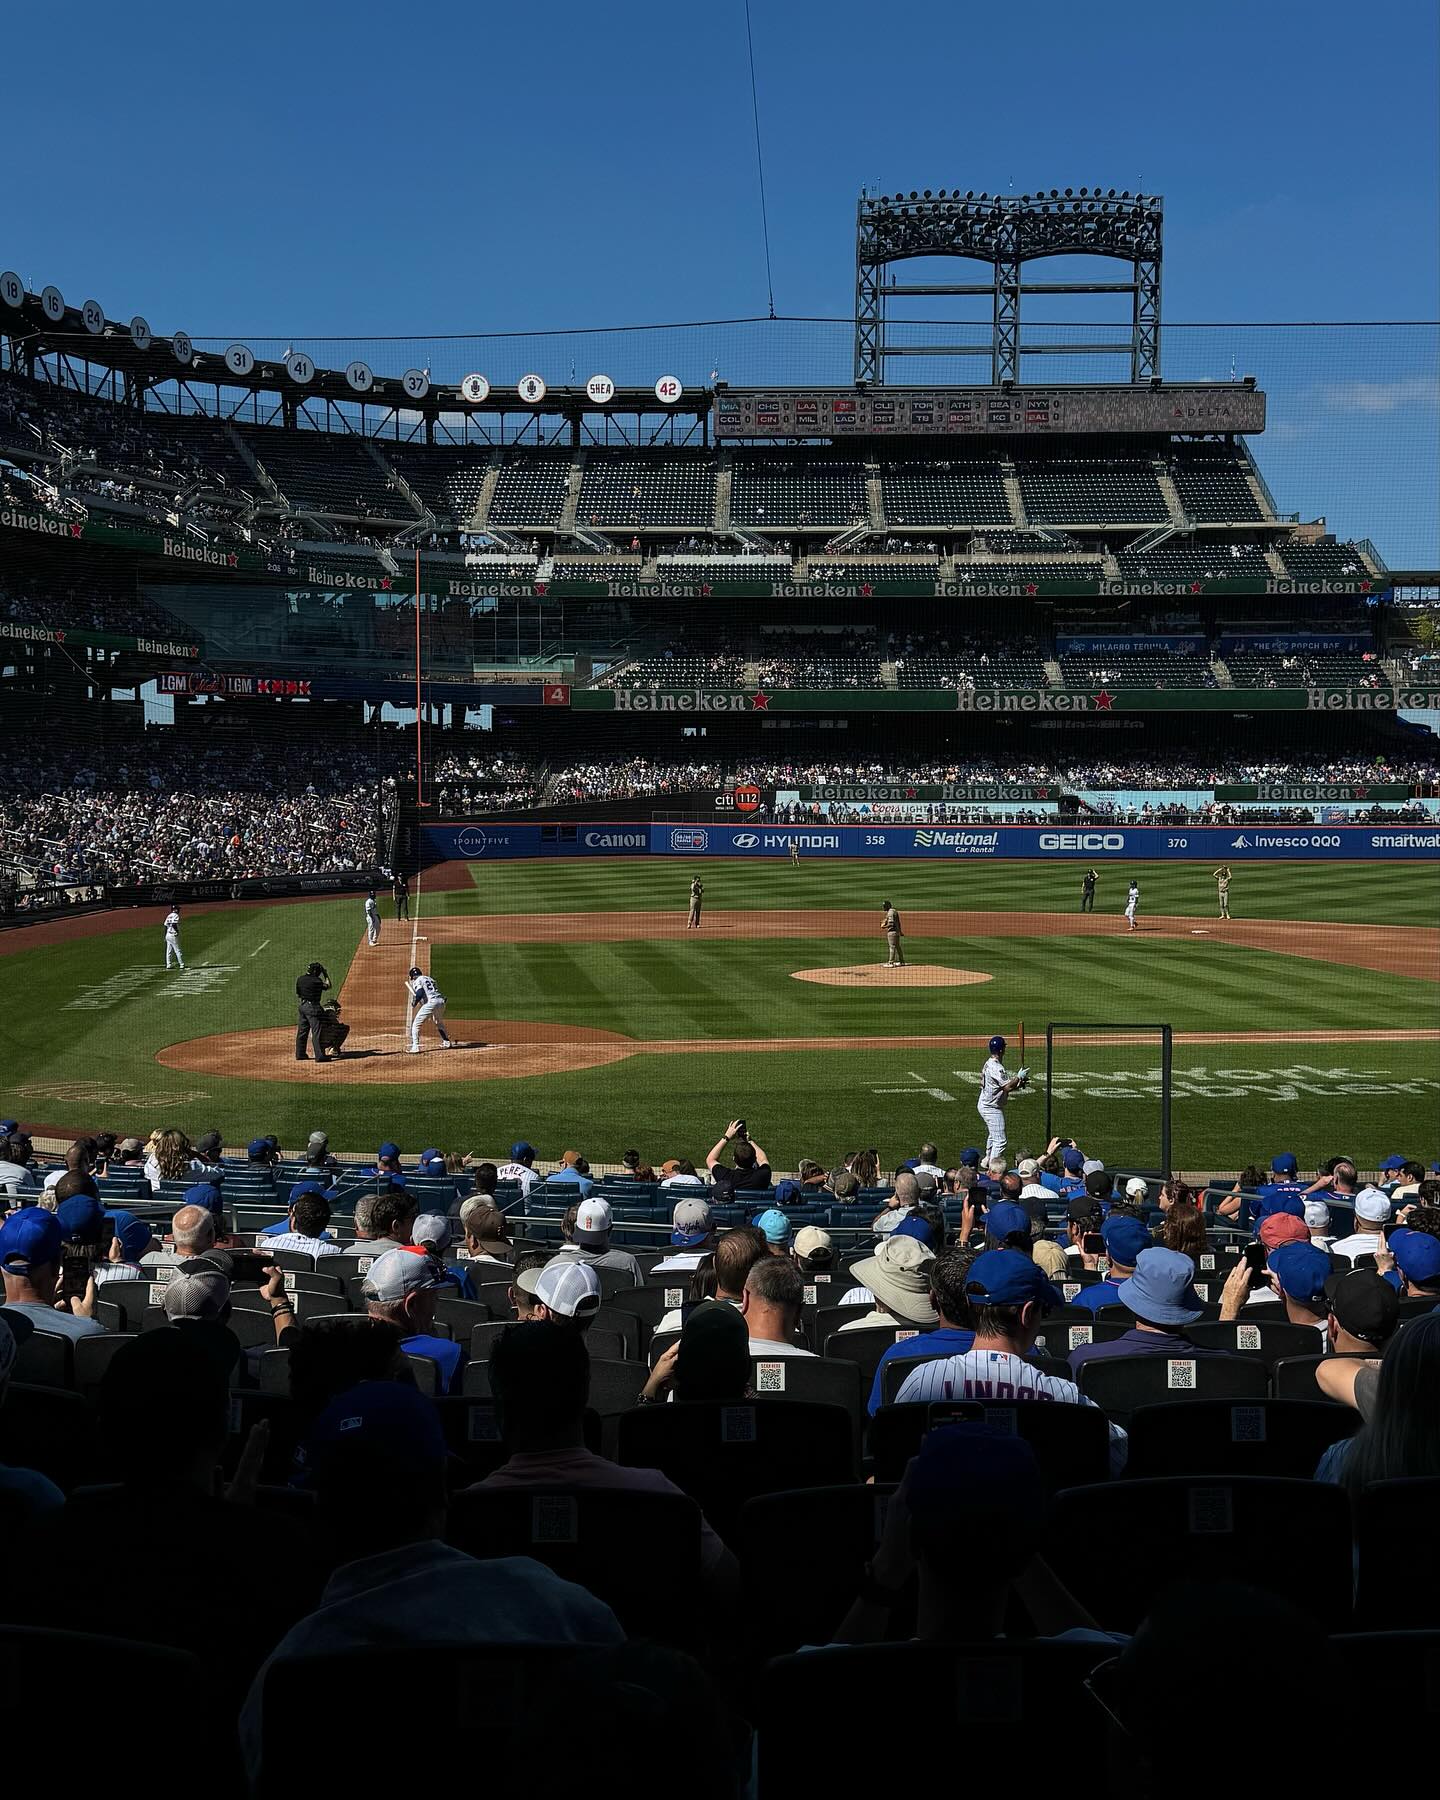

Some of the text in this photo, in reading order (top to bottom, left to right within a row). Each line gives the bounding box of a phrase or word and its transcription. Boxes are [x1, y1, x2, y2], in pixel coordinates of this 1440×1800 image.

[6, 282, 18, 298] 18
[46, 296, 59, 312] 16
[87, 309, 100, 325] 24
[135, 324, 146, 341] 17
[177, 340, 189, 356] 36
[233, 352, 247, 367] 31
[294, 361, 308, 376] 41
[353, 369, 366, 384] 14
[408, 376, 423, 391] 37
[590, 384, 611, 394] SHEA
[660, 382, 677, 396] 42
[1187, 408, 1231, 417] DELTA
[0, 507, 69, 537] eineken
[163, 537, 228, 567] Heineken
[308, 566, 378, 590] Heineken
[449, 580, 533, 597] Heineken
[608, 582, 695, 598] Heineken
[772, 582, 858, 598] Heineken
[934, 581, 1022, 596] Heineken
[1098, 580, 1187, 596] Heineken
[1266, 579, 1356, 595] Heineken
[137, 637, 190, 658] Heineken
[161, 674, 187, 691] LGM
[228, 677, 252, 693] LGM
[551, 688, 564, 703] 4
[613, 689, 747, 711] Heineken
[957, 689, 1089, 711] Heineken
[1306, 688, 1440, 710] Heineken
[740, 793, 757, 803] 112
[812, 785, 902, 800] Heineken
[942, 785, 1034, 800] Heineken
[1256, 784, 1351, 800] Heineken
[715, 794, 734, 806] citi
[872, 801, 901, 814] Coors
[901, 805, 928, 814] LIGHT
[453, 836, 510, 846] 1POINTFIVE
[585, 832, 646, 848] Canon
[764, 835, 839, 848] HYUNDAI
[865, 835, 885, 845] 358
[933, 831, 998, 846] National
[1039, 833, 1124, 850] GEICO
[1167, 837, 1188, 848] 370
[1255, 835, 1341, 848] Invesco QQQ
[199, 885, 225, 897] DELTA
[499, 1165, 527, 1178] PEREZ
